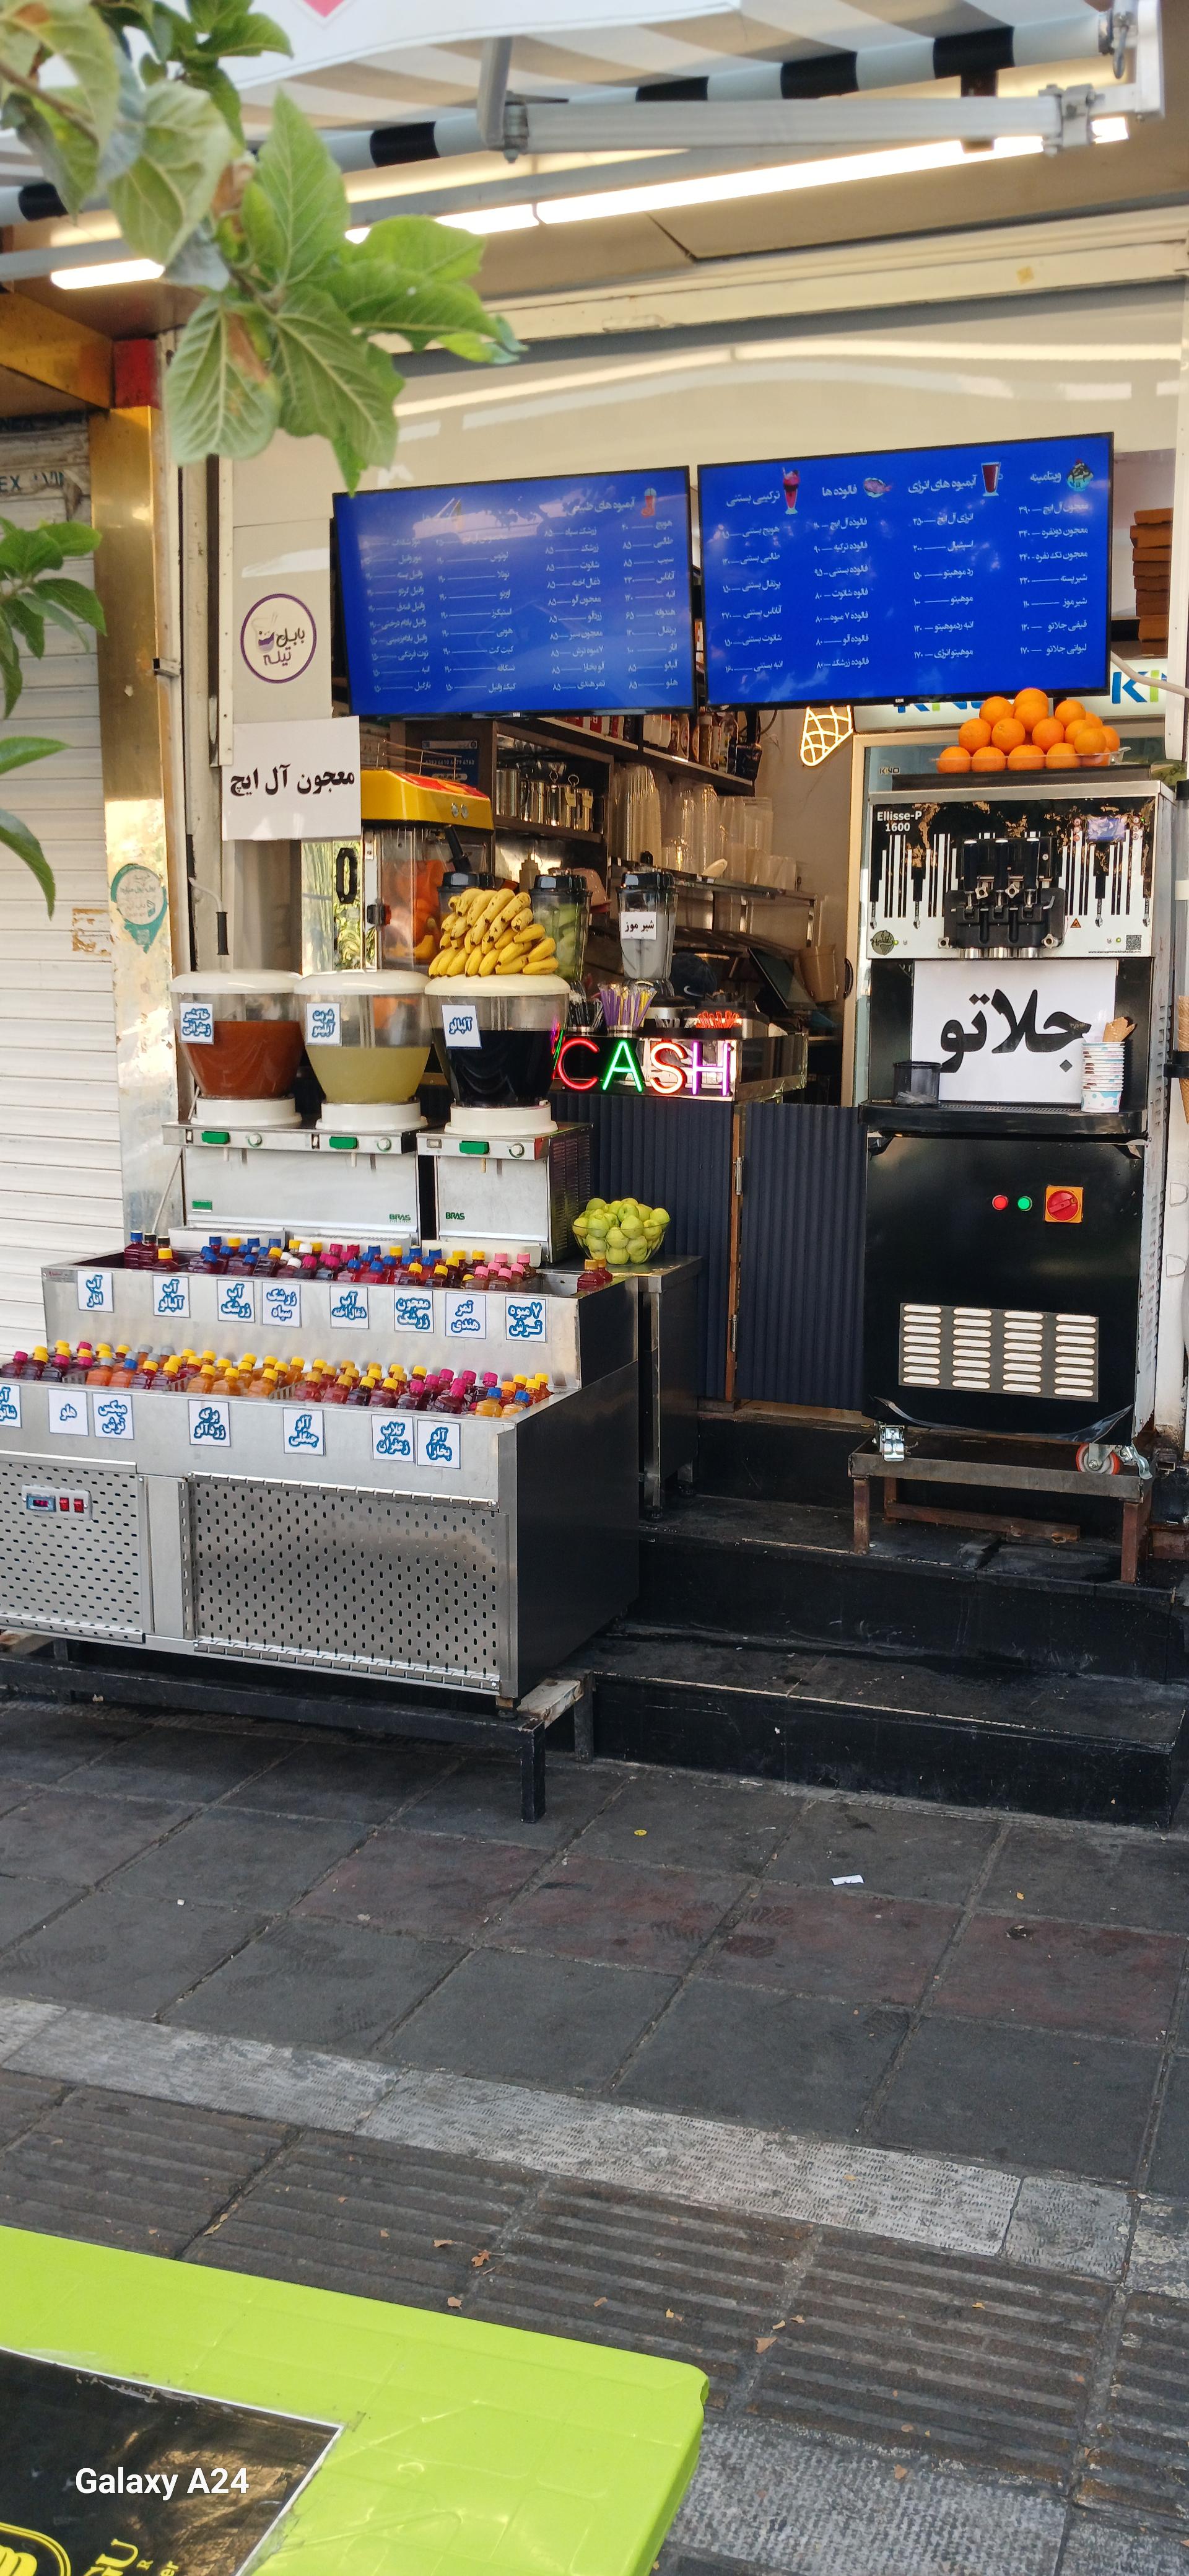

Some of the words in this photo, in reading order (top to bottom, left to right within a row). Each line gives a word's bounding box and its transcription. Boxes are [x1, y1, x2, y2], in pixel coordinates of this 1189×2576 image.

[952, 474, 977, 491] آبمیوه
[1030, 471, 1061, 483] ویتامینه
[822, 486, 832, 496] ها
[834, 484, 858, 499] فالوده
[908, 480, 930, 494] انرژی
[930, 479, 950, 492] های
[614, 496, 635, 512] آبمیوه
[726, 494, 752, 507] بستنی
[753, 491, 780, 505] ترکیبی
[594, 500, 612, 513] های
[1063, 527, 1088, 537] معجون
[850, 541, 868, 552] فالوده
[1035, 551, 1050, 563] نفره
[1063, 551, 1088, 561] معجون
[829, 567, 849, 577] بستنی
[850, 564, 868, 576] فالوده
[943, 569, 967, 579] موهیتو
[742, 582, 761, 592] بستنی
[951, 595, 973, 605] موهیتو
[1062, 598, 1074, 608] موز
[1074, 597, 1087, 608] شیر
[743, 609, 762, 619] بستنی
[830, 614, 844, 623] میوه
[850, 611, 869, 621] فالوده
[964, 621, 974, 631] انبه
[1047, 621, 1067, 633] جلاتو
[1068, 620, 1087, 631] قیفی
[742, 635, 761, 646] بستنی
[842, 634, 850, 646] آلو
[851, 634, 869, 645] فالوده
[934, 649, 951, 659] انرژی
[951, 649, 973, 659] موهیتو
[1047, 645, 1066, 655] جلاتو
[1066, 643, 1087, 655] لیوانی
[754, 662, 773, 672] بستنی
[851, 657, 869, 668] فالوده
[230, 768, 259, 797] ایچ
[265, 763, 291, 795] آل
[297, 768, 355, 795] معجون
[877, 810, 923, 821] Ellisse-P
[885, 823, 910, 831] 1600
[625, 921, 638, 932] موز
[641, 919, 655, 932] شیر
[449, 1017, 473, 1035] آلبالو
[940, 989, 1092, 1073] جلاتو
[557, 1037, 732, 1097] CASH
[445, 1212, 465, 1220] BRAS
[86, 1275, 103, 1290] آب
[162, 1279, 180, 1294] آب
[227, 1283, 245, 1299] آب
[158, 1295, 185, 1312] آلبالو
[266, 1289, 297, 1307] زرشک
[341, 1290, 358, 1306] آب
[396, 1297, 431, 1312] معجون
[221, 1300, 251, 1318] زرشک
[271, 1305, 292, 1321] سیاه
[455, 1300, 474, 1316] تمر
[508, 1305, 531, 1319] میوه
[531, 1302, 542, 1318] ۷
[397, 1310, 430, 1329] زرشک
[450, 1318, 481, 1333] هندی
[509, 1320, 543, 1337] ترش
[60, 1403, 77, 1421] هلو
[98, 1400, 128, 1417] میکس
[102, 1417, 126, 1434] ترش
[295, 1414, 312, 1432] آلو
[194, 1421, 226, 1440] زردآلو
[430, 1427, 449, 1444] آلو
[289, 1430, 319, 1448] جنگلی
[377, 1436, 410, 1455] زعفران
[426, 1442, 452, 1461] بخارا
